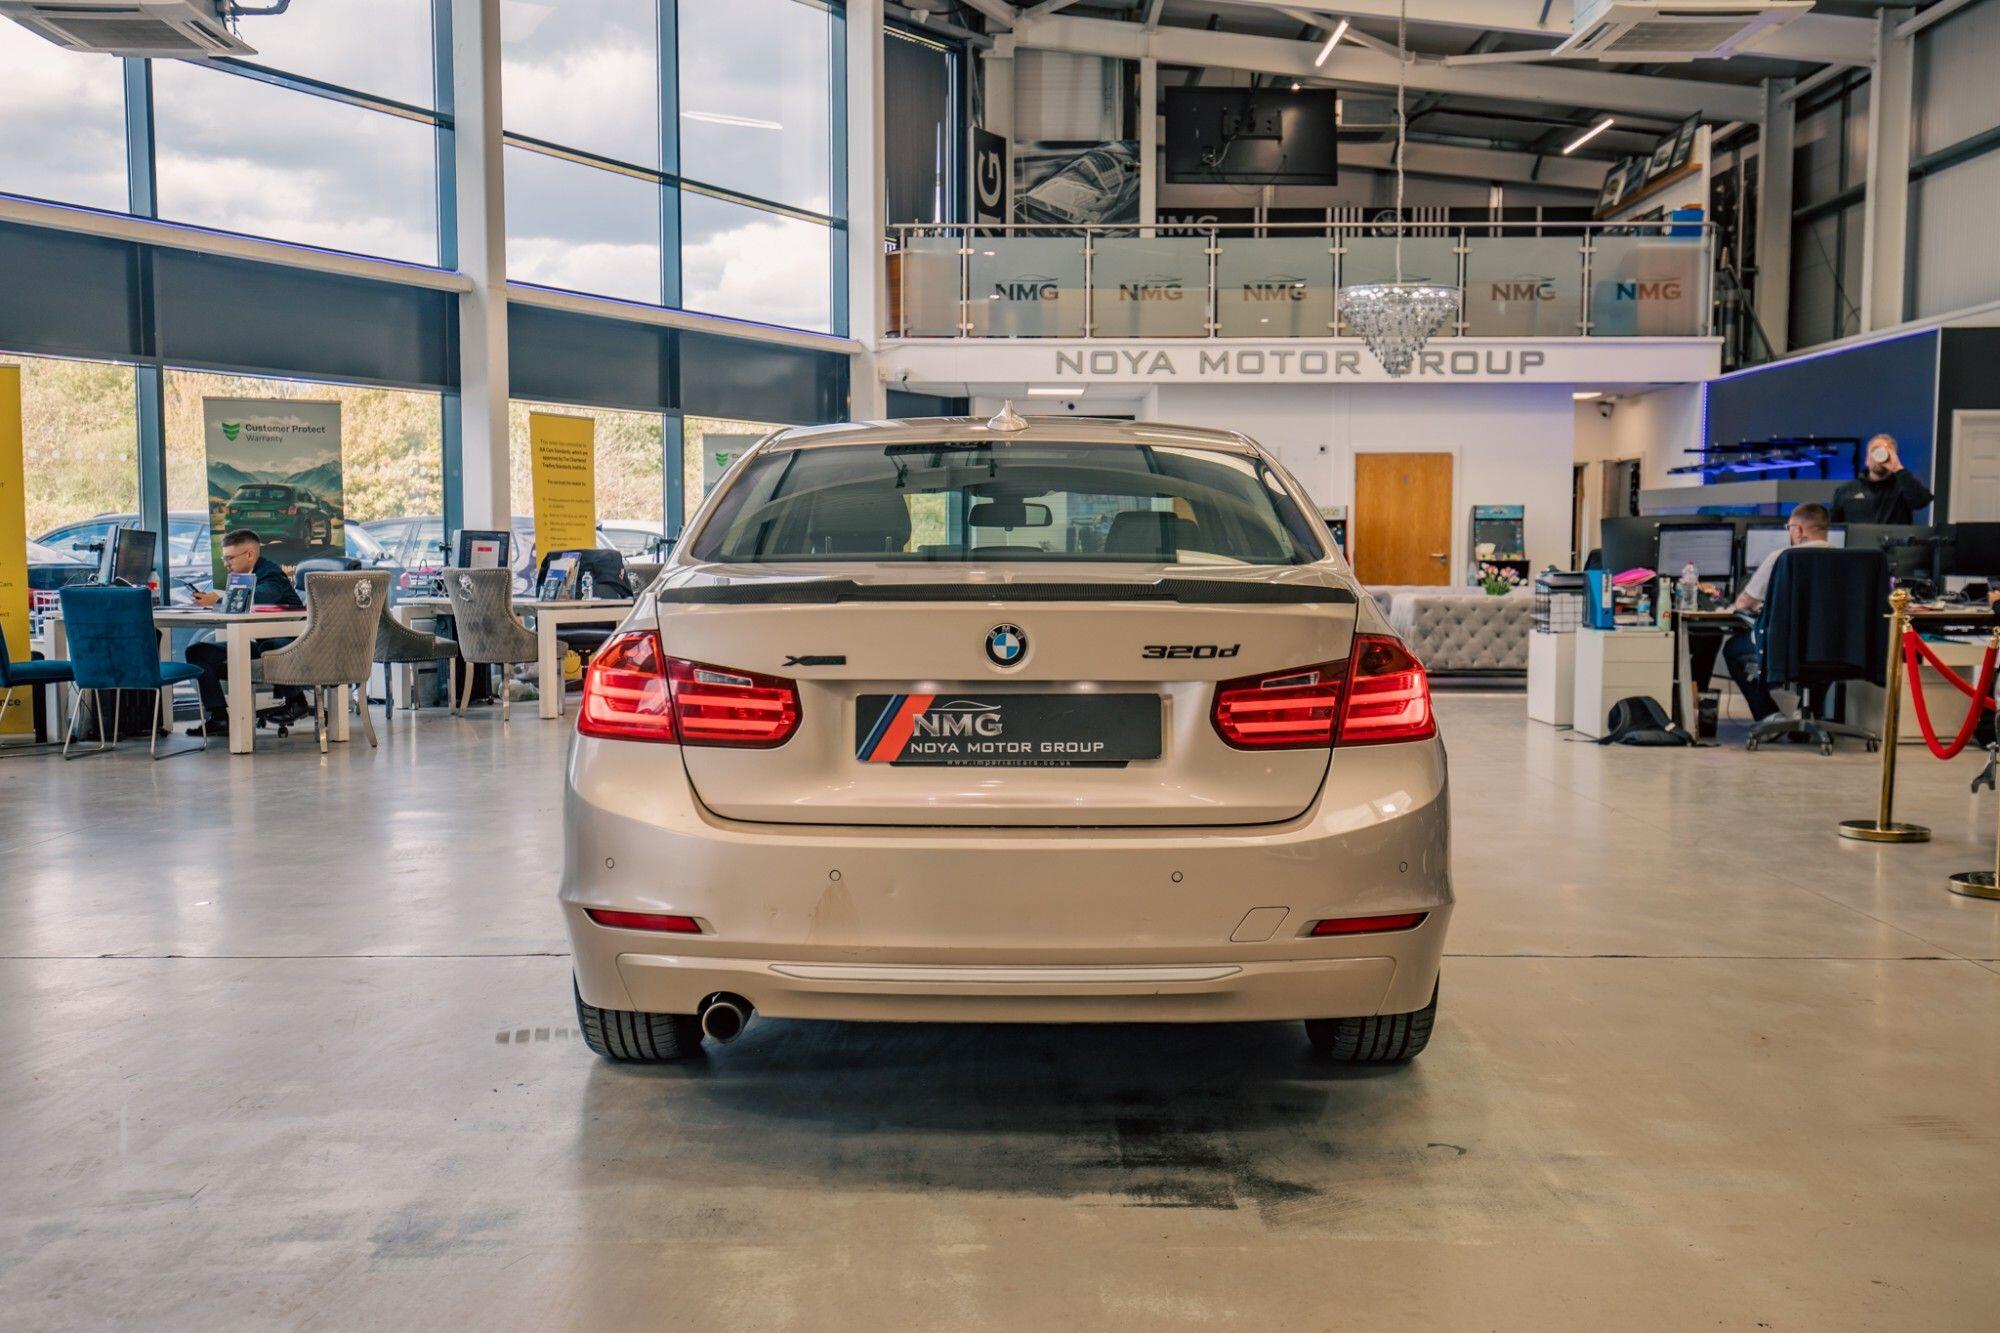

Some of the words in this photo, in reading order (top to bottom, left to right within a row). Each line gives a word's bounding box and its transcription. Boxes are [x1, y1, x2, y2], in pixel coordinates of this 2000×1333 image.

[995, 283, 1059, 301] NMG
[1119, 283, 1184, 301] NMG
[1243, 283, 1307, 301] NMG
[1491, 283, 1556, 301] NMG
[1616, 283, 1682, 300] NMG
[1055, 350, 1177, 375] NOYA
[1199, 350, 1362, 375] MOTOR
[245, 423, 290, 433] Customer
[292, 425, 326, 434] Protect
[245, 434, 283, 444] Warranty
[989, 624, 1025, 641] BMW
[1142, 643, 1241, 659] 320d
[912, 712, 1003, 738] NMG
[911, 742, 960, 754] NOYA
[968, 742, 1032, 753] MOTOR
[1040, 742, 1105, 753] GROUP
